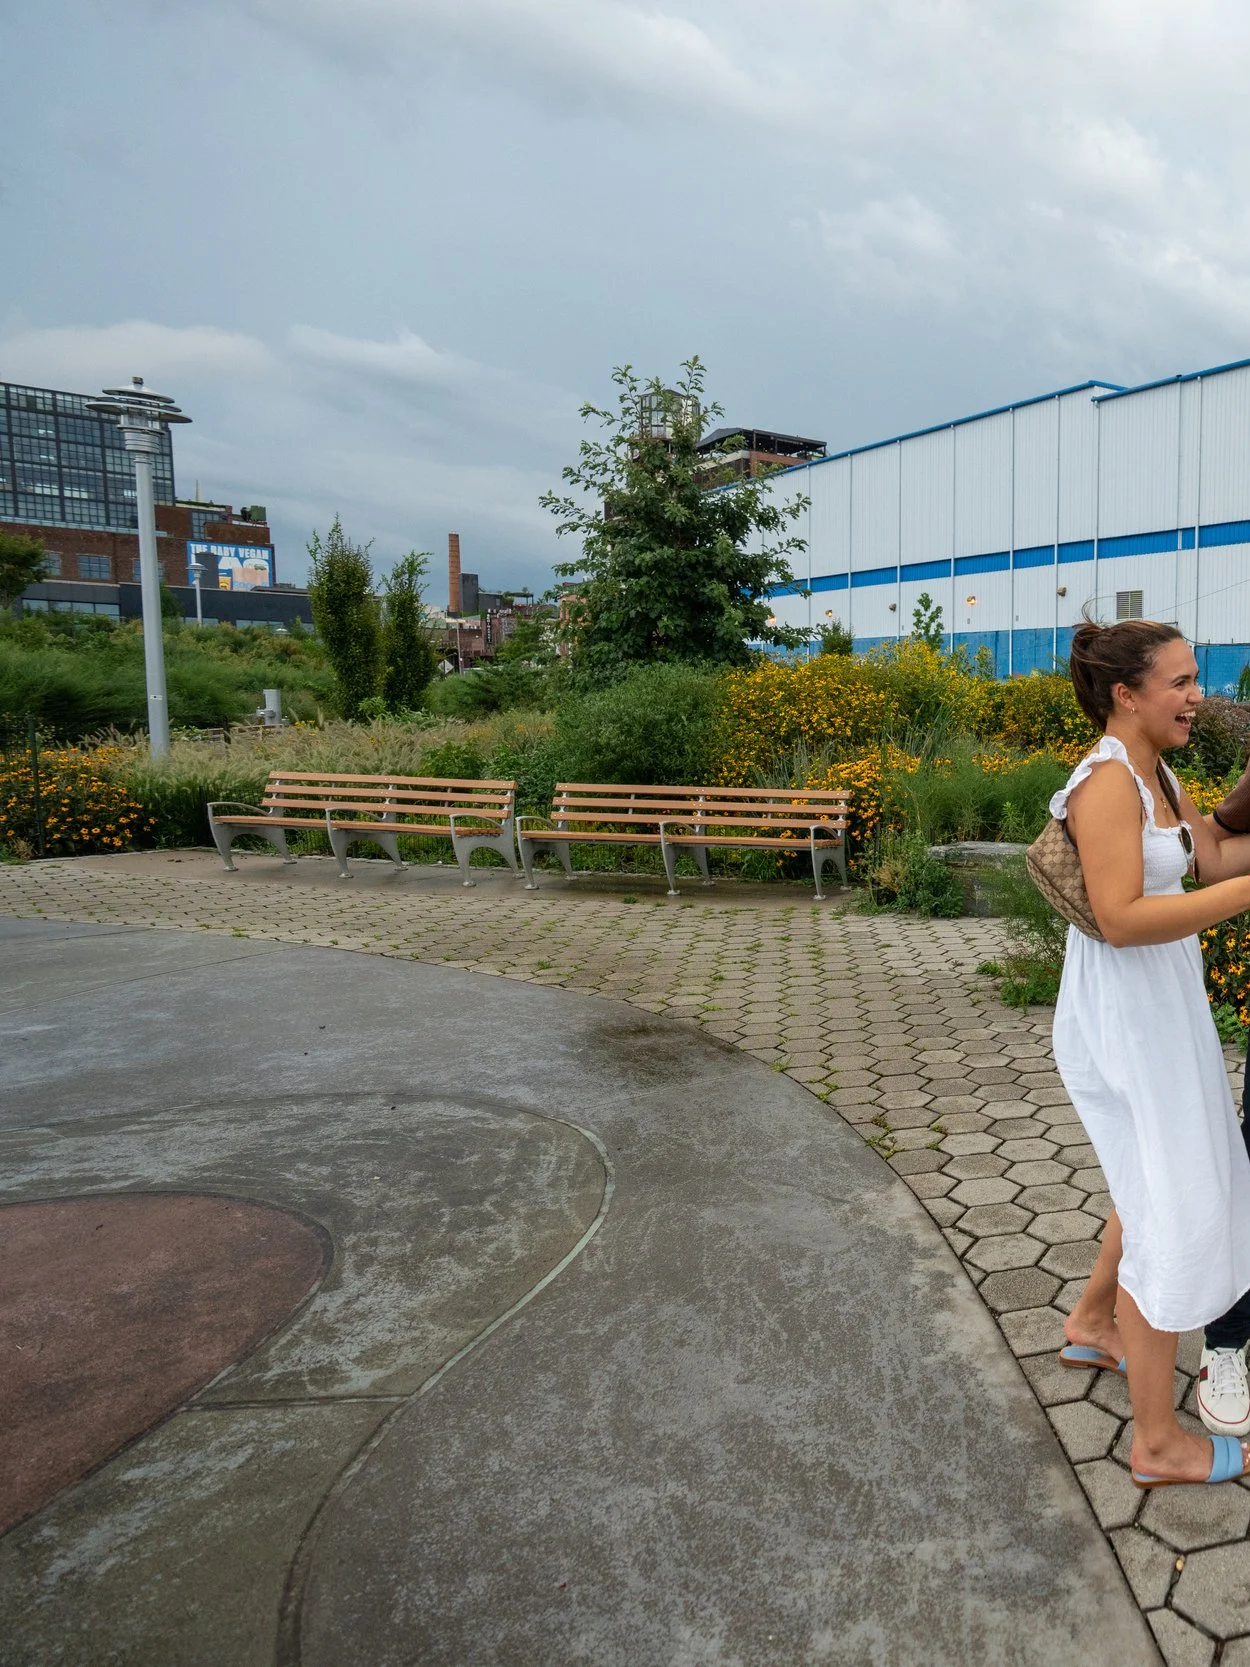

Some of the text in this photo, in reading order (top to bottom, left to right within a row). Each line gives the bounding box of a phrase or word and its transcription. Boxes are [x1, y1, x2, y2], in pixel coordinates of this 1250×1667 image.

[190, 543, 269, 560] THE BABY VEGAN
